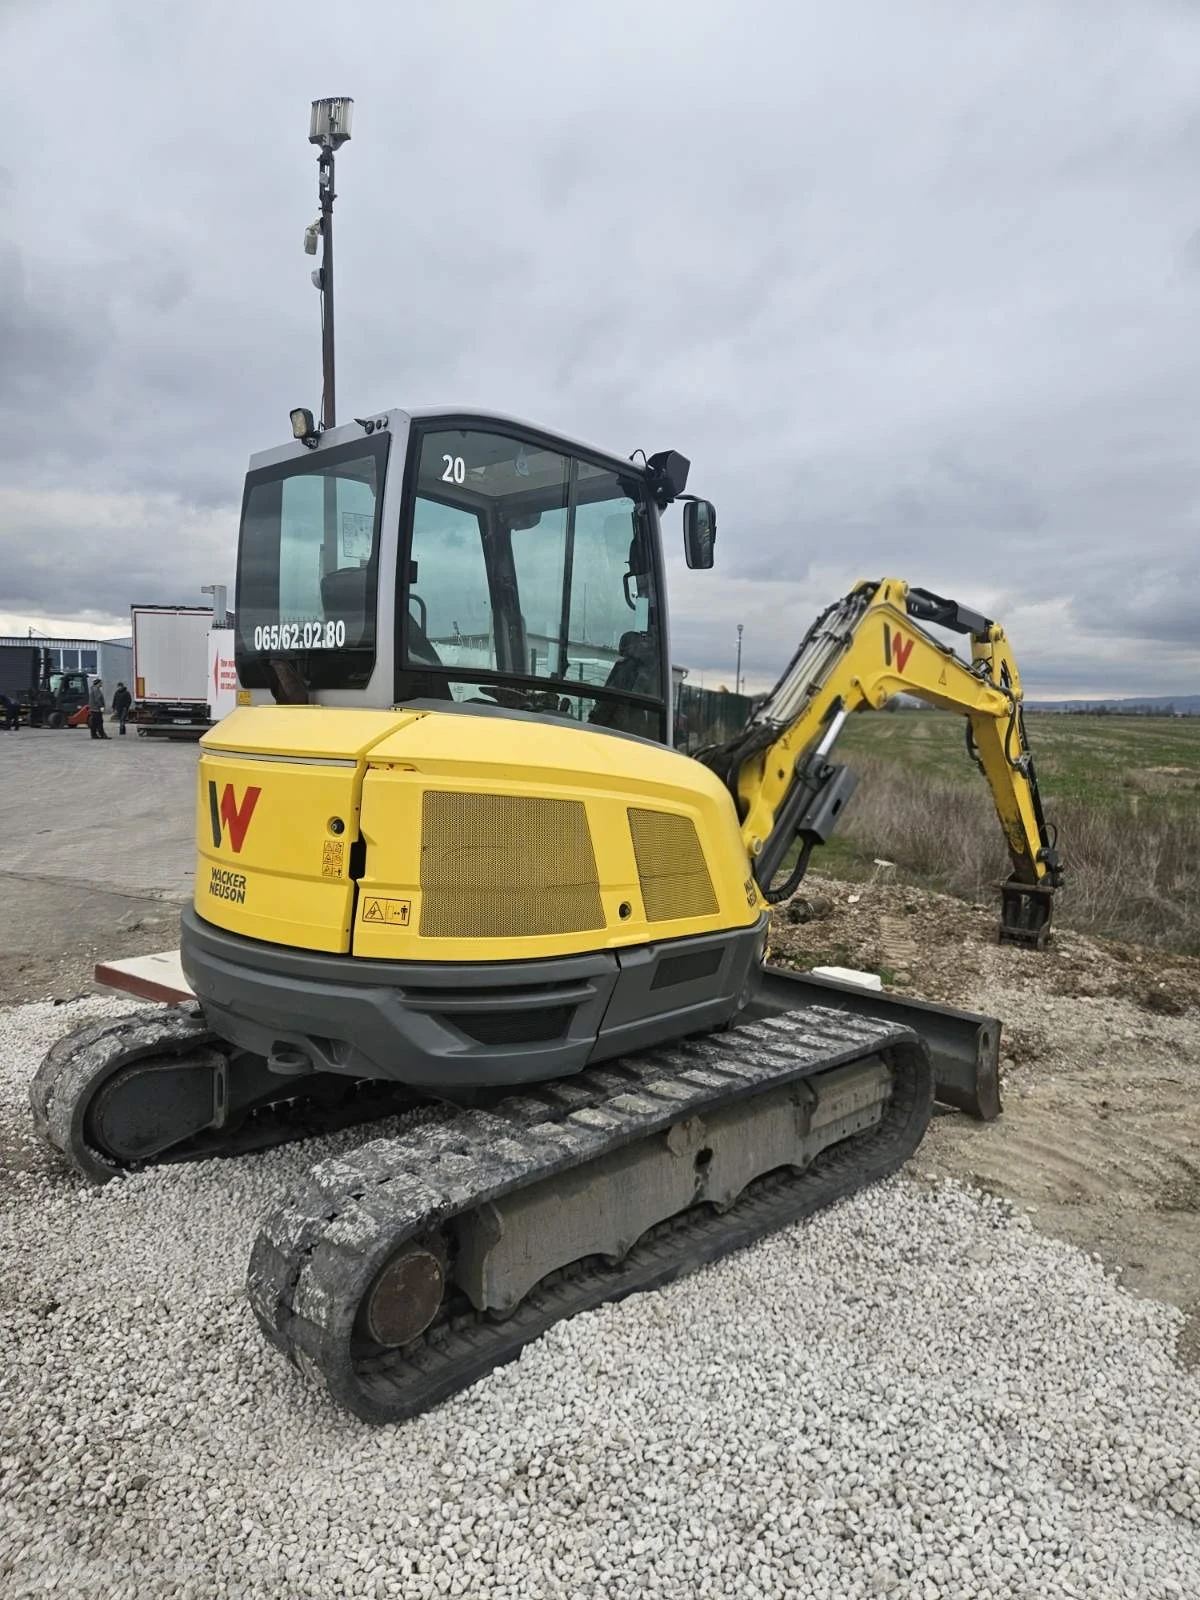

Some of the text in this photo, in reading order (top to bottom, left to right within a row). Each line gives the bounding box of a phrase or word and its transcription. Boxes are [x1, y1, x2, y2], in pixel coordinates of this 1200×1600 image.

[442, 454, 466, 484] 20
[254, 620, 346, 650] 065/62.02.80
[211, 867, 247, 890] WACKER
[209, 881, 246, 904] NEUSON
